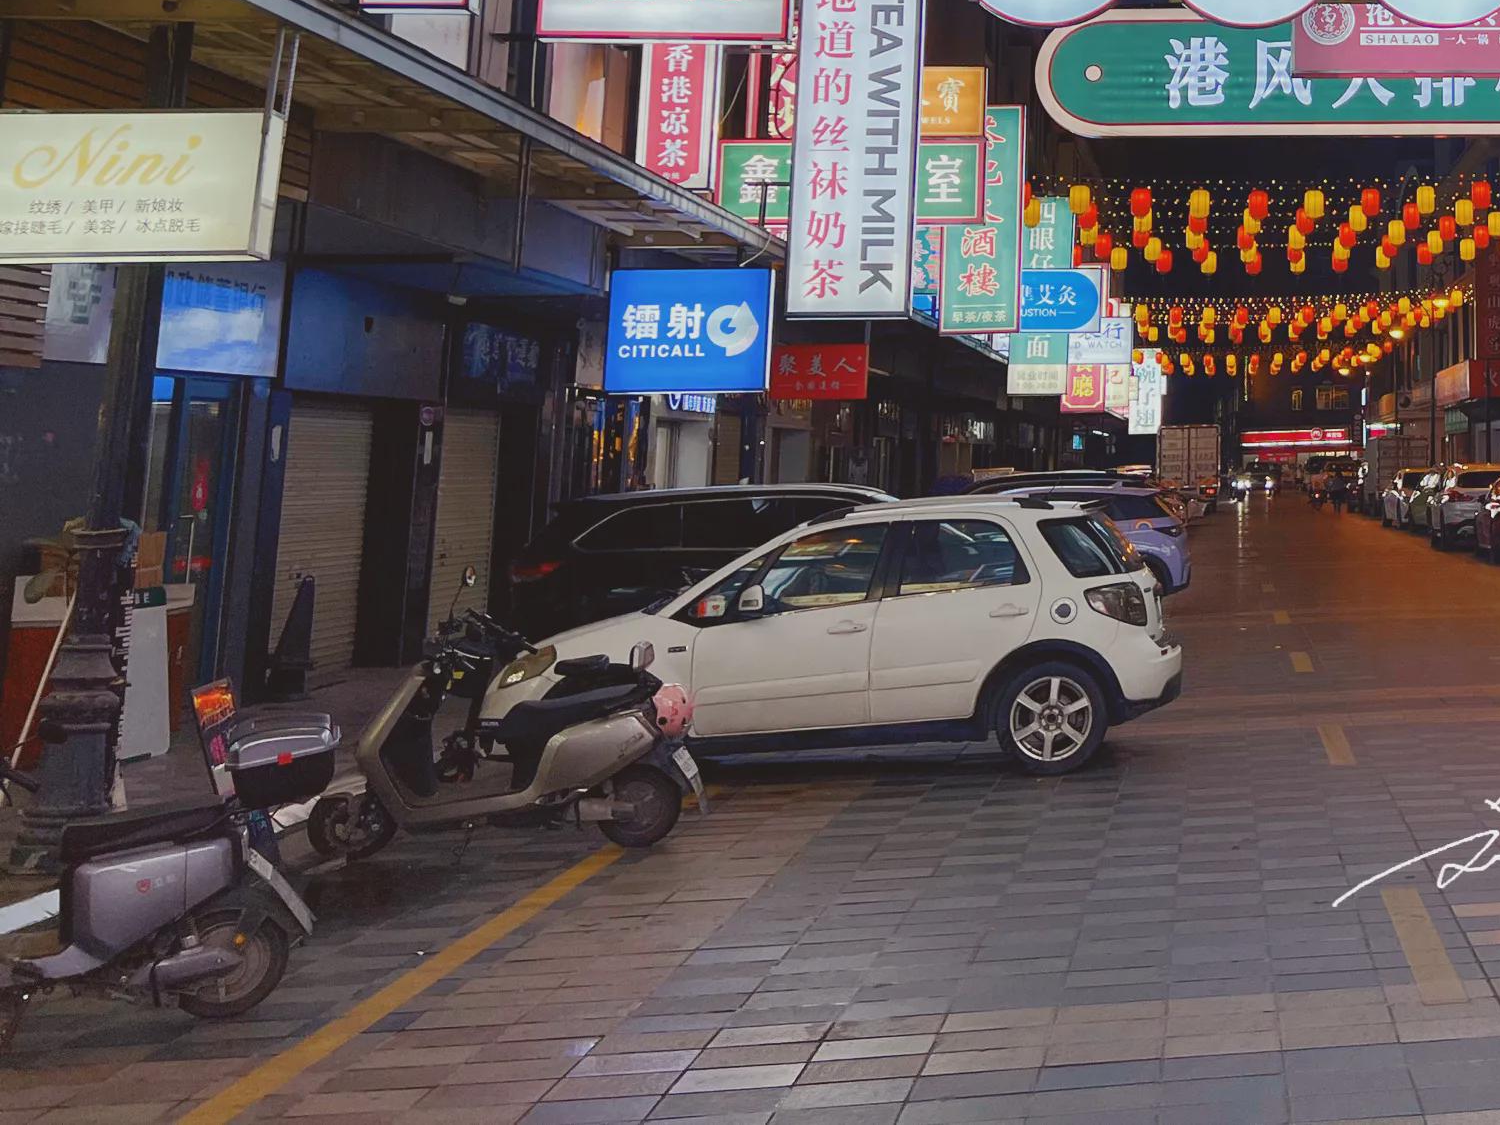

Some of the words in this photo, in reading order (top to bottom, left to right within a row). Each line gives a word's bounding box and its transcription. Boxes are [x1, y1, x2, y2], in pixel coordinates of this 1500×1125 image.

[1364, 33, 1435, 45] SHALAO
[656, 43, 694, 169] 香港凉茶
[863, 63, 903, 177] WITH
[12, 123, 203, 190] Nini
[81, 198, 126, 215] 美甲/
[134, 198, 185, 214] 新娘妆
[82, 219, 128, 235] 美容/
[135, 218, 202, 234] 冰点脱毛
[857, 188, 898, 295] MILK
[621, 302, 705, 341] 镭射
[617, 343, 706, 359] CITICALL
